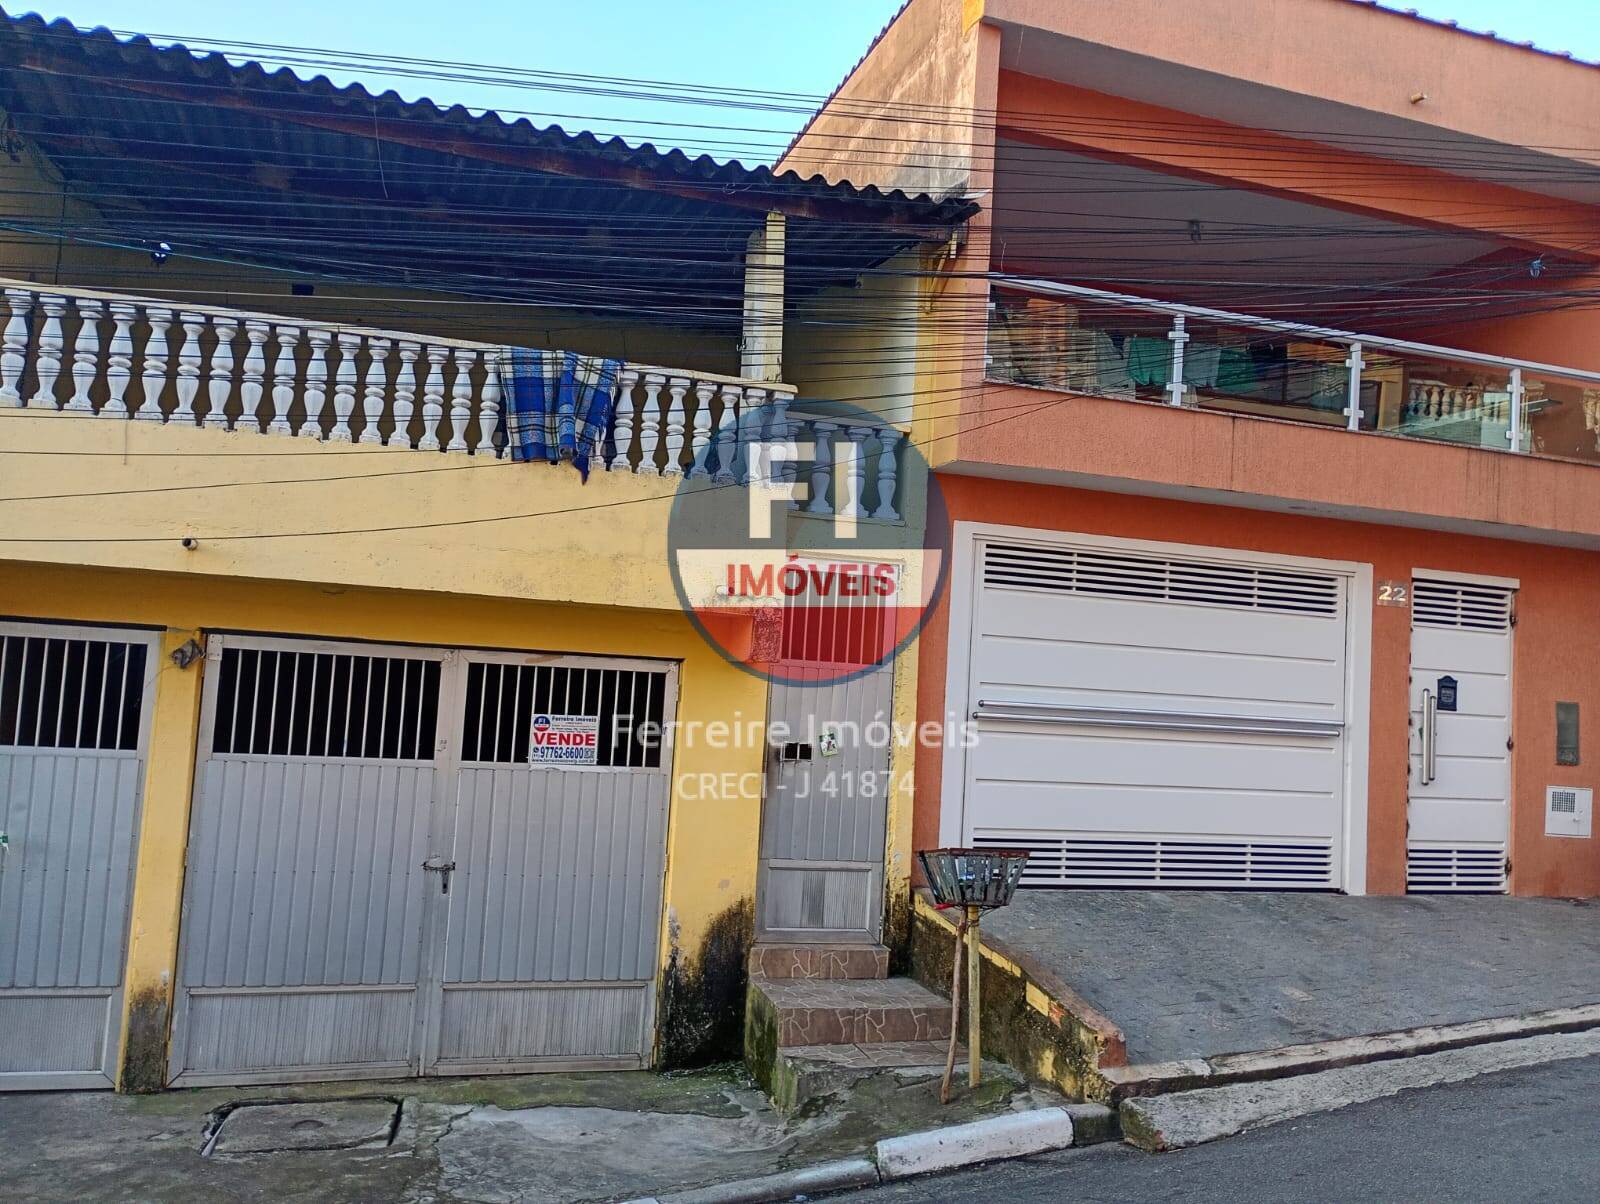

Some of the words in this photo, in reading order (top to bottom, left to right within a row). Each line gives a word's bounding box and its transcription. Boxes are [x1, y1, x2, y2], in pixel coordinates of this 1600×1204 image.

[1379, 585, 1406, 601] 22
[533, 732, 596, 746] VENDE
[540, 746, 584, 759] 97762-6600
